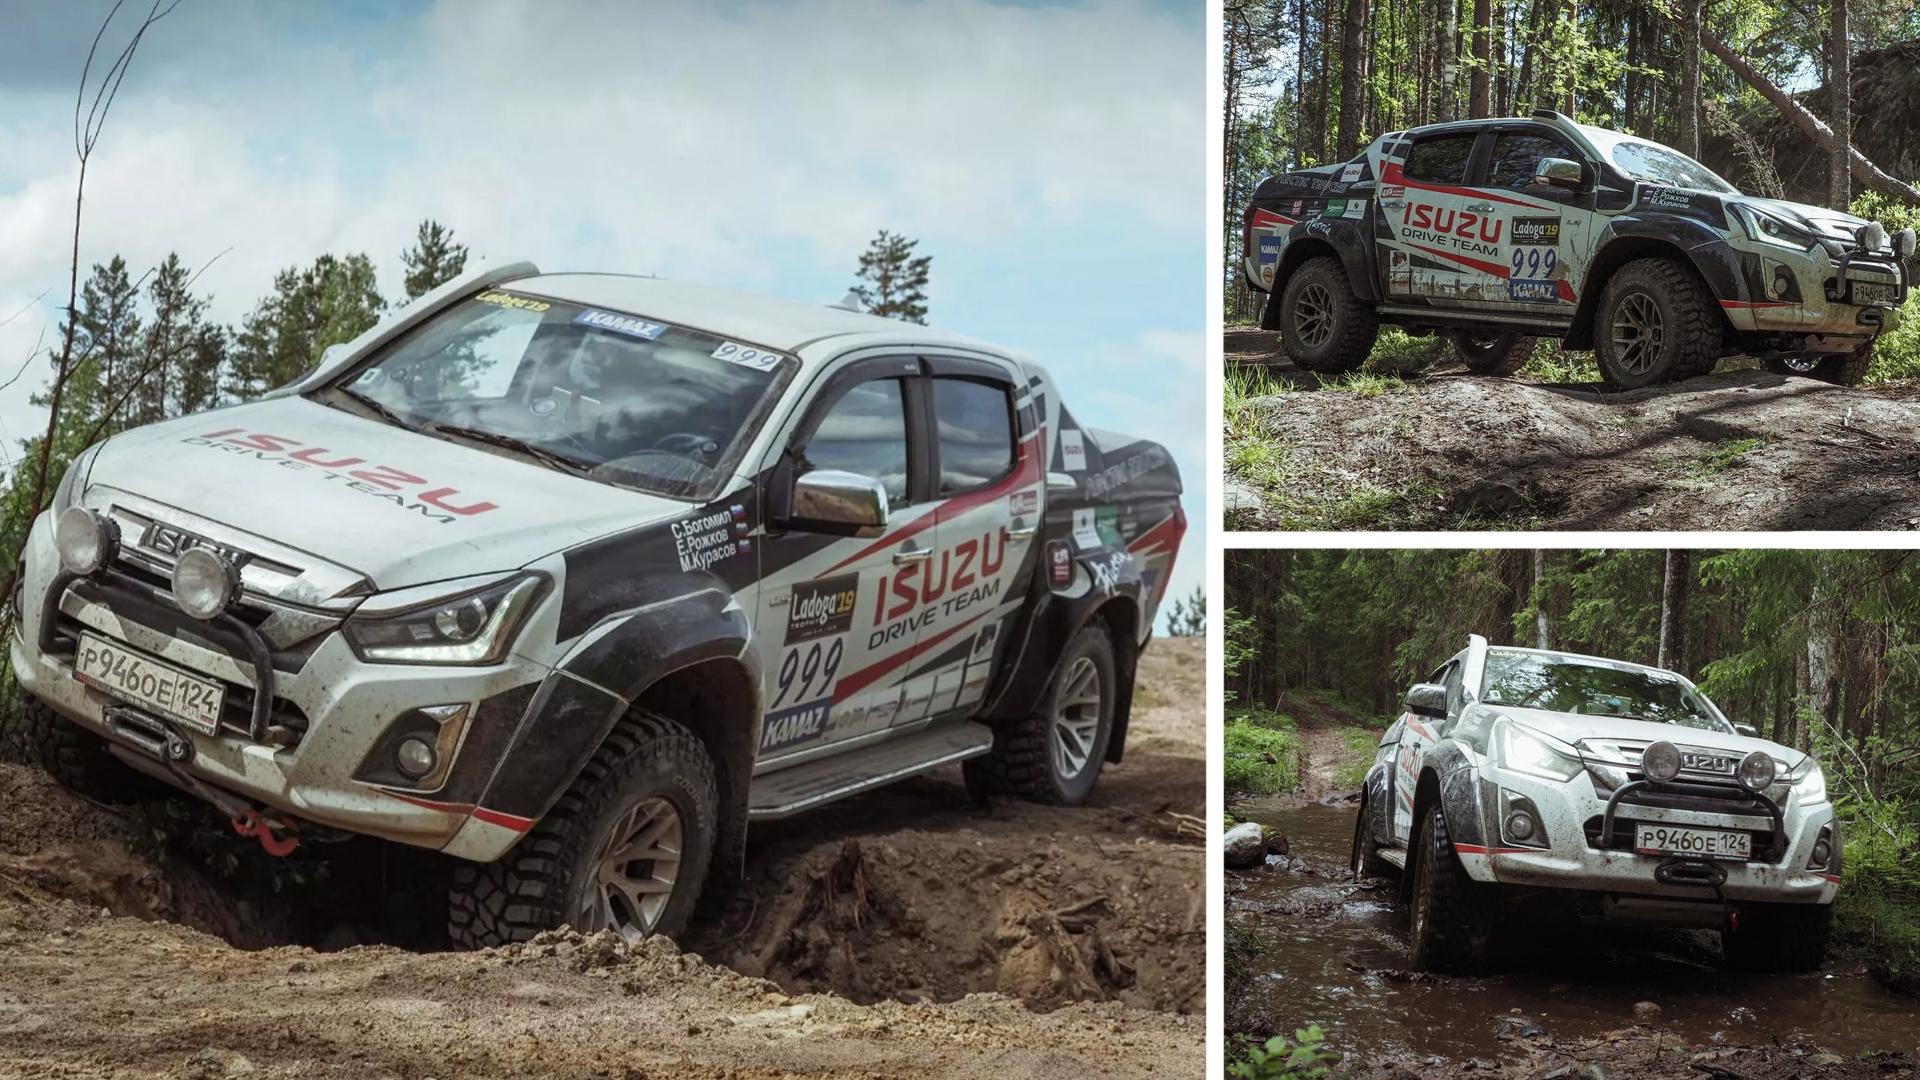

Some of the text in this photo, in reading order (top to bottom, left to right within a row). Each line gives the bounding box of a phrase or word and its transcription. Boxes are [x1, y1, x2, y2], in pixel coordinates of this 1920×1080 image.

[1275, 174, 1348, 194] ARCTIC TRUCKS
[1653, 190, 1690, 204] Е.Рожков
[1650, 197, 1690, 209] М.Курасов
[1403, 201, 1503, 244] ISUZU
[1512, 220, 1559, 239] Ladoga'19
[1260, 244, 1279, 254] KAMAZ
[1401, 227, 1498, 257] DRIVE TEAM
[1511, 247, 1557, 279] 999
[1512, 283, 1555, 300] KAMAZ
[583, 311, 660, 337] KAMAZ
[721, 344, 777, 369] 999
[180, 437, 456, 524] DRIVE TEAM
[201, 428, 500, 516] ISUZU
[671, 510, 732, 540] С.Богомил
[676, 529, 729, 556] Е.Рожков
[679, 543, 737, 573] М.Курасов
[873, 525, 1006, 628] ISUZU
[792, 589, 855, 625] Ladoga'19
[868, 577, 1001, 651] DRIVE TEAM
[771, 636, 843, 710] 999
[178, 679, 214, 715] 124
[180, 703, 201, 720] RUS
[761, 706, 826, 749] KAMAZ
[1683, 754, 1729, 771] UZU
[1643, 828, 1746, 853] P946OE 124
